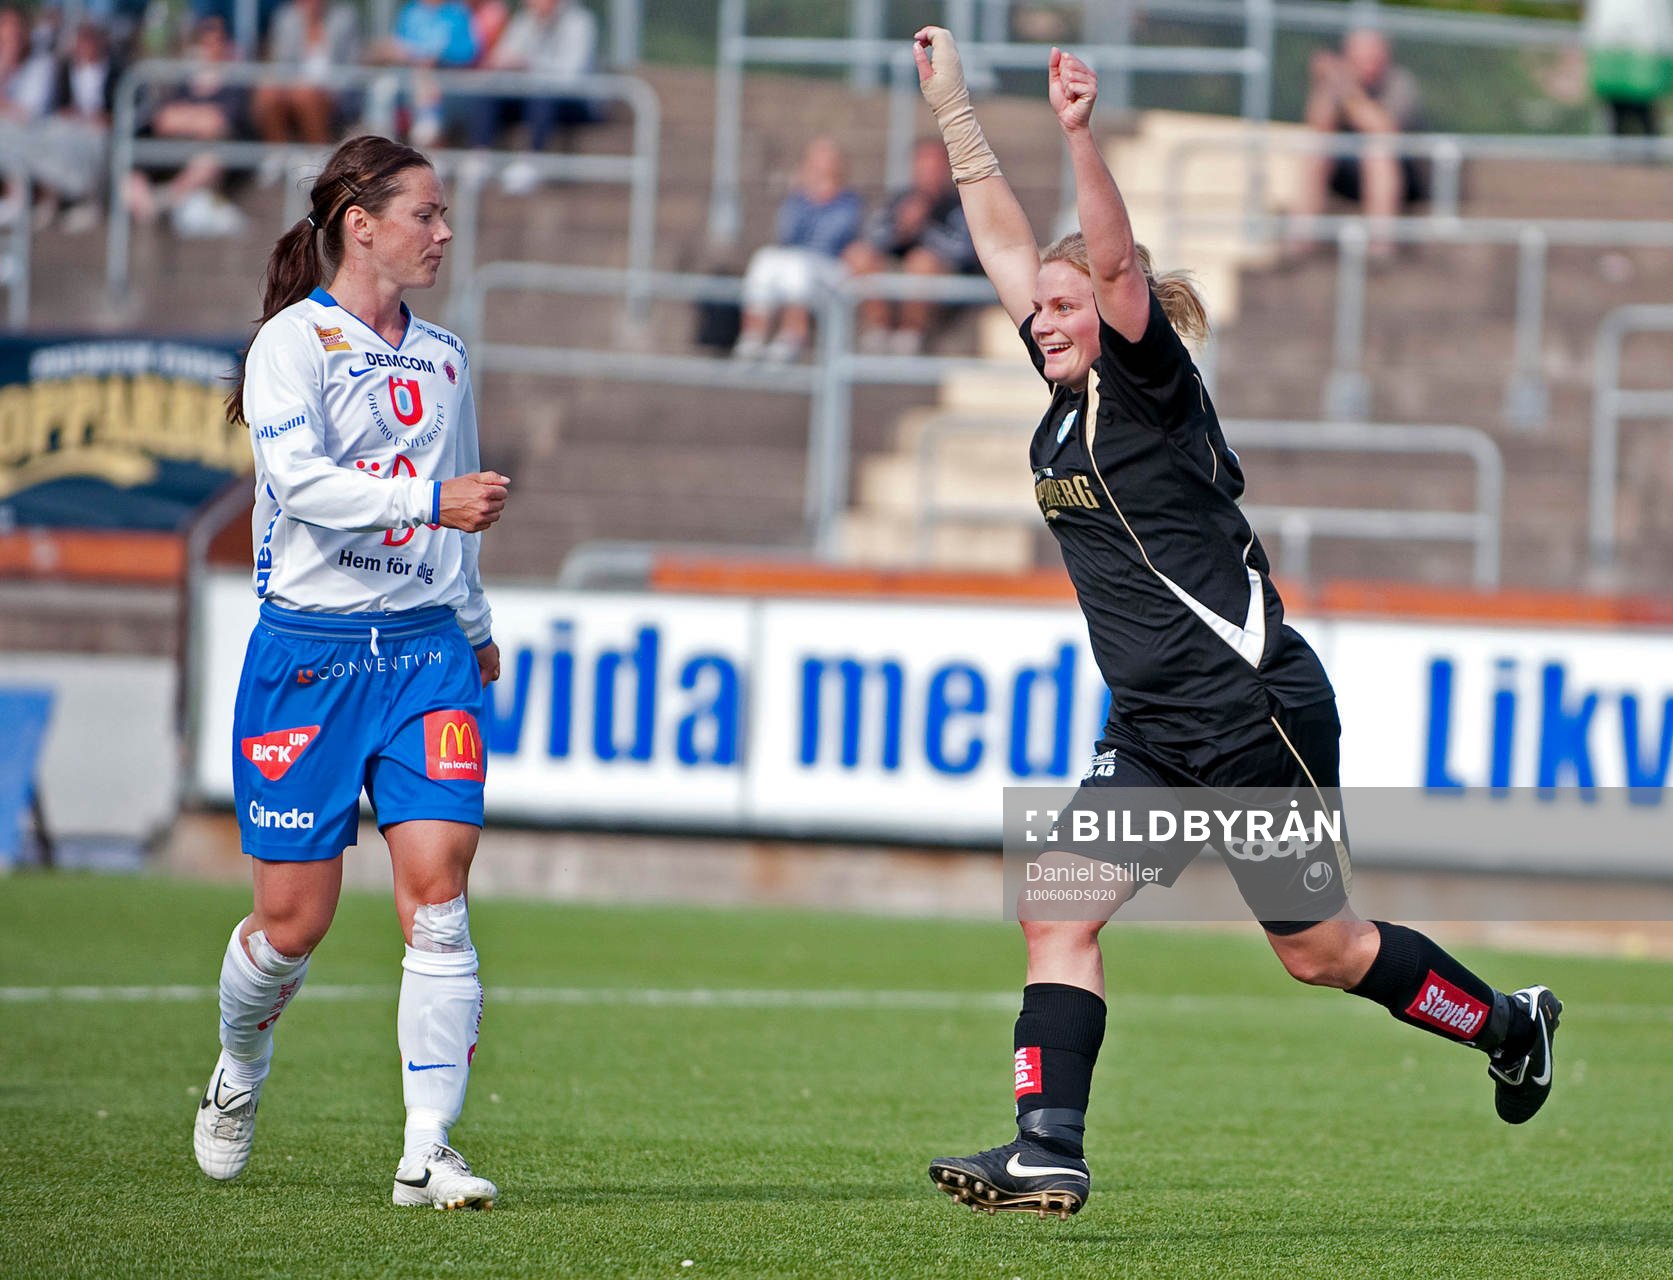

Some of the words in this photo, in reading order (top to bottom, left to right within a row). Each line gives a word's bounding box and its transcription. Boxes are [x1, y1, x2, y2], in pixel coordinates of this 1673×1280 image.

[365, 352, 436, 374] DEMCOM
[256, 413, 306, 441] olksam
[367, 392, 393, 442] ÖREBRO
[394, 402, 444, 448] UNIVERSITET
[339, 549, 380, 572] Hem
[386, 557, 412, 576] för
[417, 561, 434, 585] dig
[486, 618, 740, 768] vida
[800, 641, 1077, 779] med
[289, 732, 309, 746] UP
[1423, 656, 1673, 806] Likv
[1094, 764, 1116, 777] AB
[1419, 984, 1483, 1034] Stavdal
[1015, 1047, 1035, 1091] vdal
